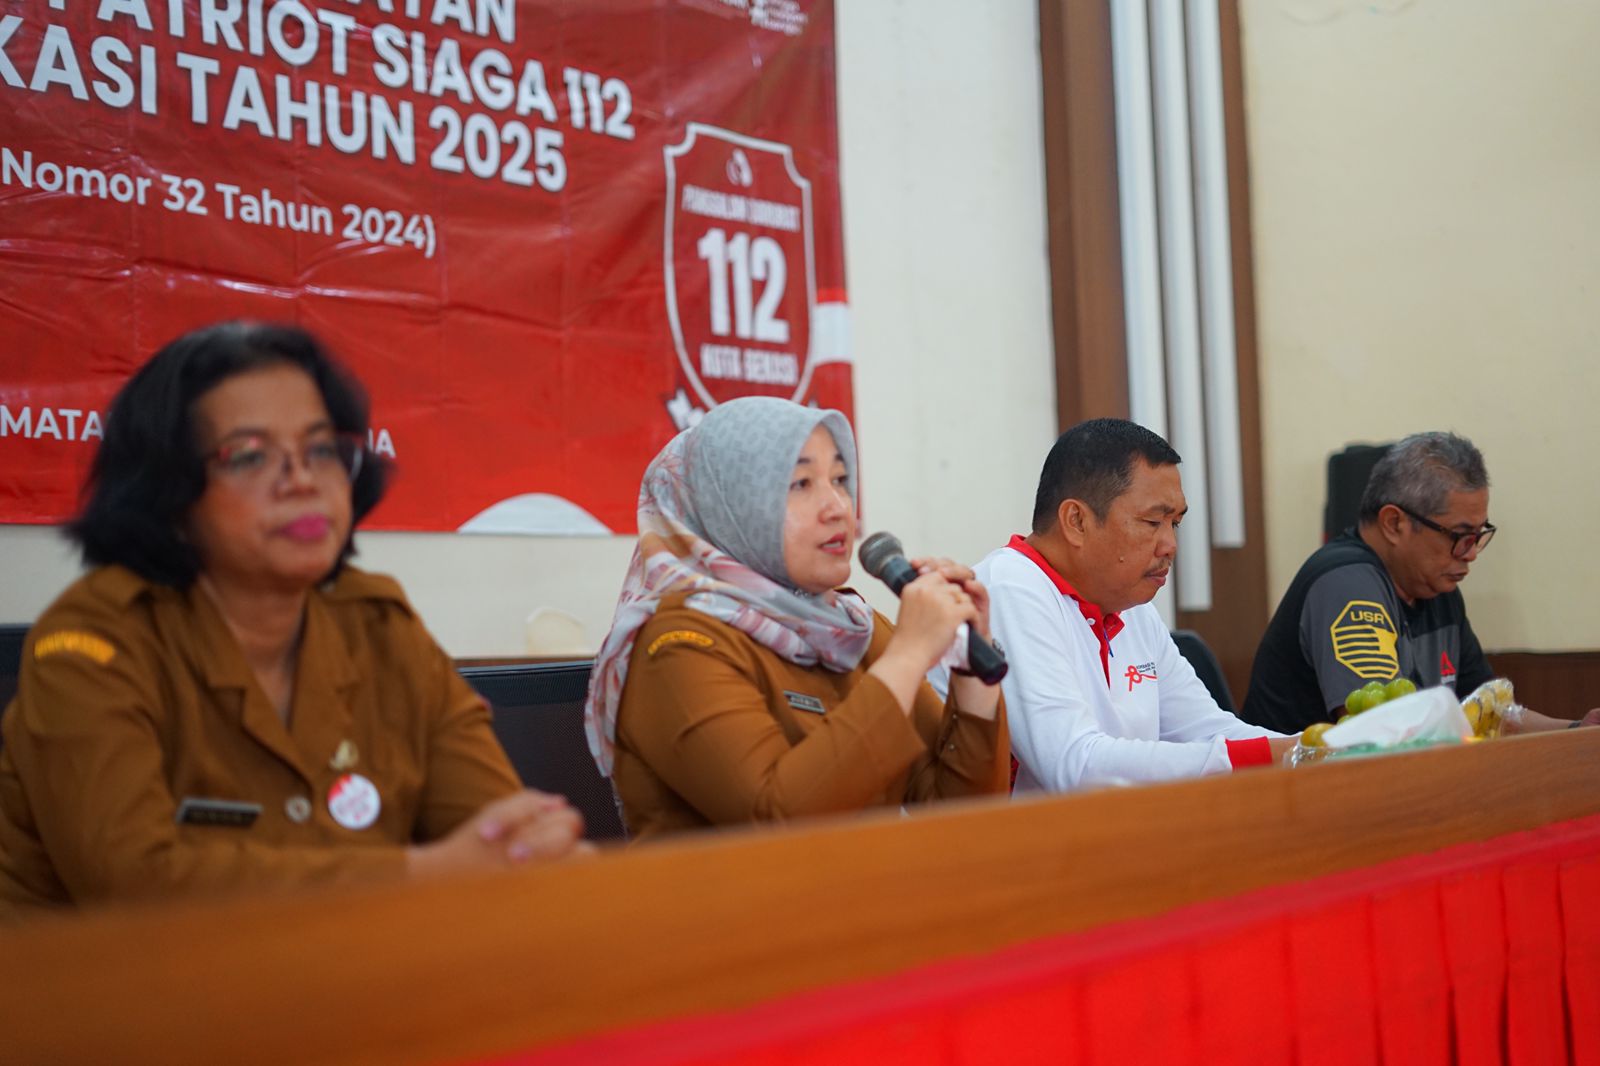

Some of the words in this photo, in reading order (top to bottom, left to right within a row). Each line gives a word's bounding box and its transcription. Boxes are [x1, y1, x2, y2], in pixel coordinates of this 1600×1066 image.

[176, 52, 416, 165] TAHUN
[429, 105, 567, 192] 2025
[372, 23, 557, 122] SIAGA
[563, 67, 634, 141] 112
[1, 147, 151, 205] Nomor
[162, 173, 207, 216] 32
[215, 183, 333, 235] Tahun
[342, 203, 437, 258] 2024)
[697, 227, 790, 344] 112
